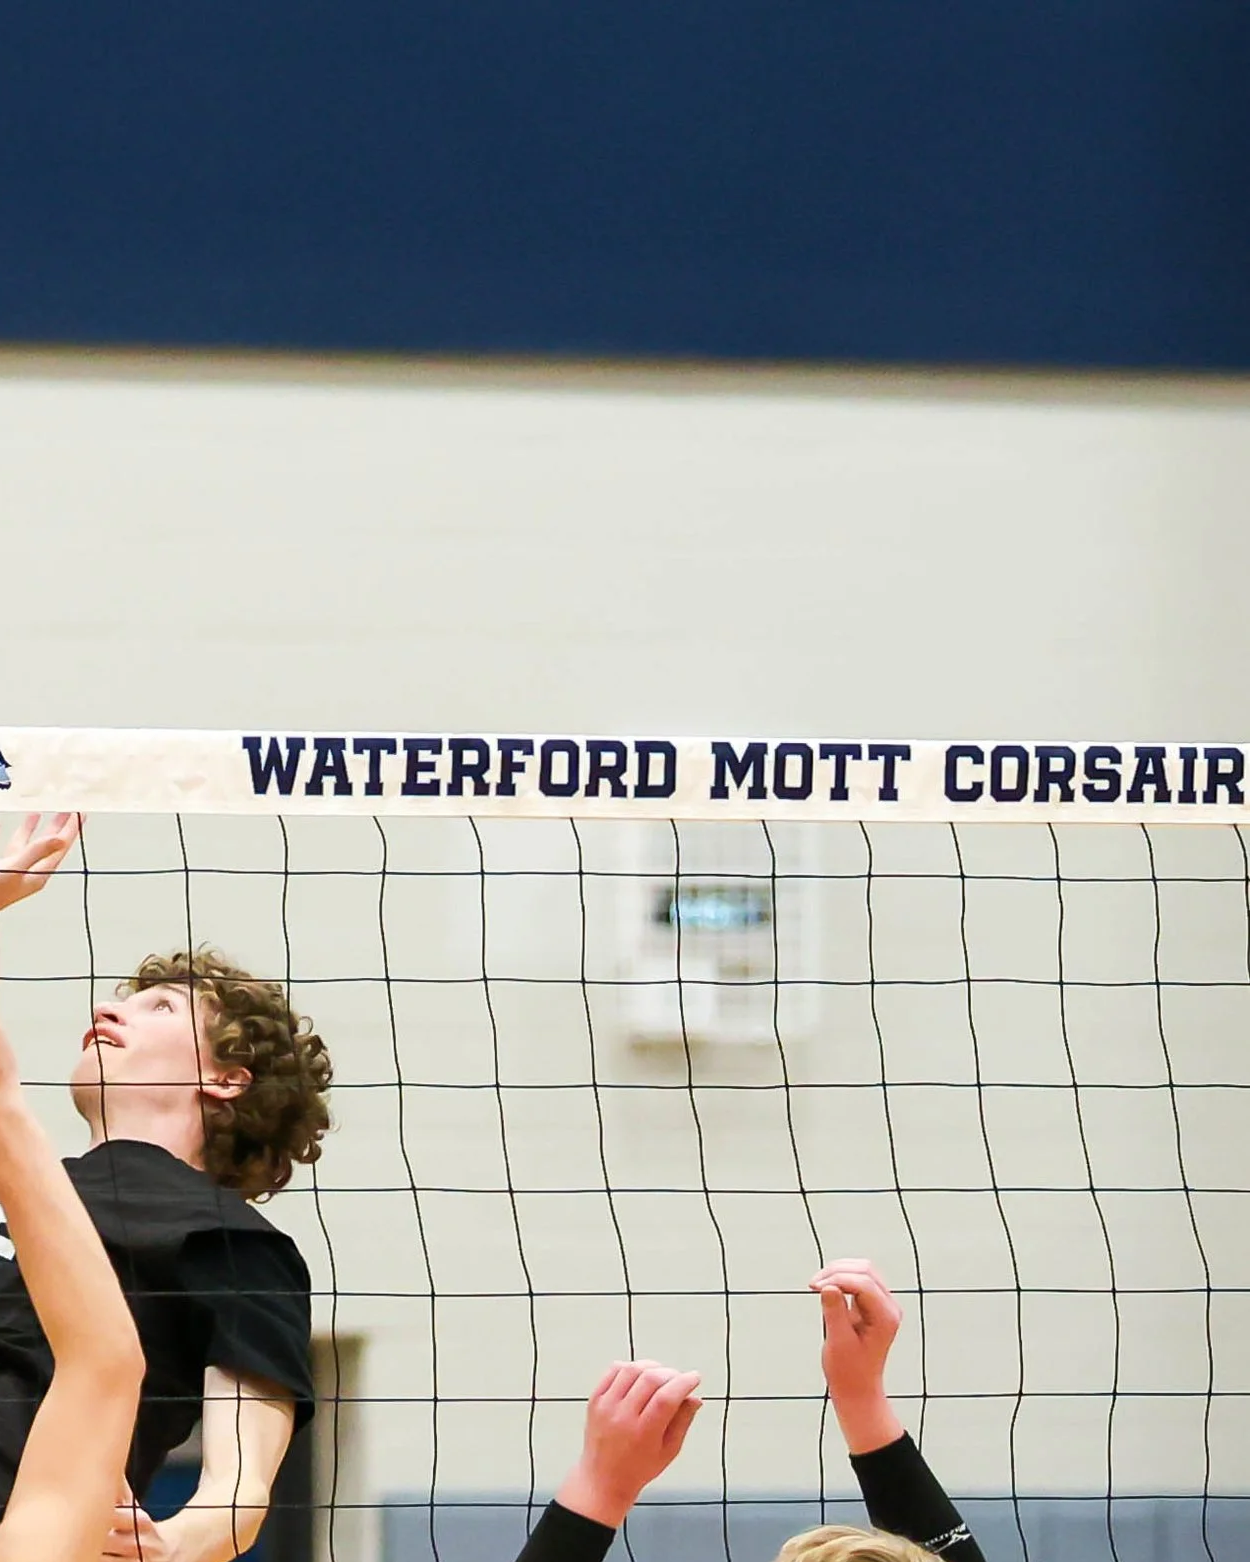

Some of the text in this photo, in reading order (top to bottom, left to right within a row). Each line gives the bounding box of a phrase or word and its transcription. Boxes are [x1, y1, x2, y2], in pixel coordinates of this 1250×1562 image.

[242, 736, 1245, 805] WATERFORD MOTT CORSAIR
